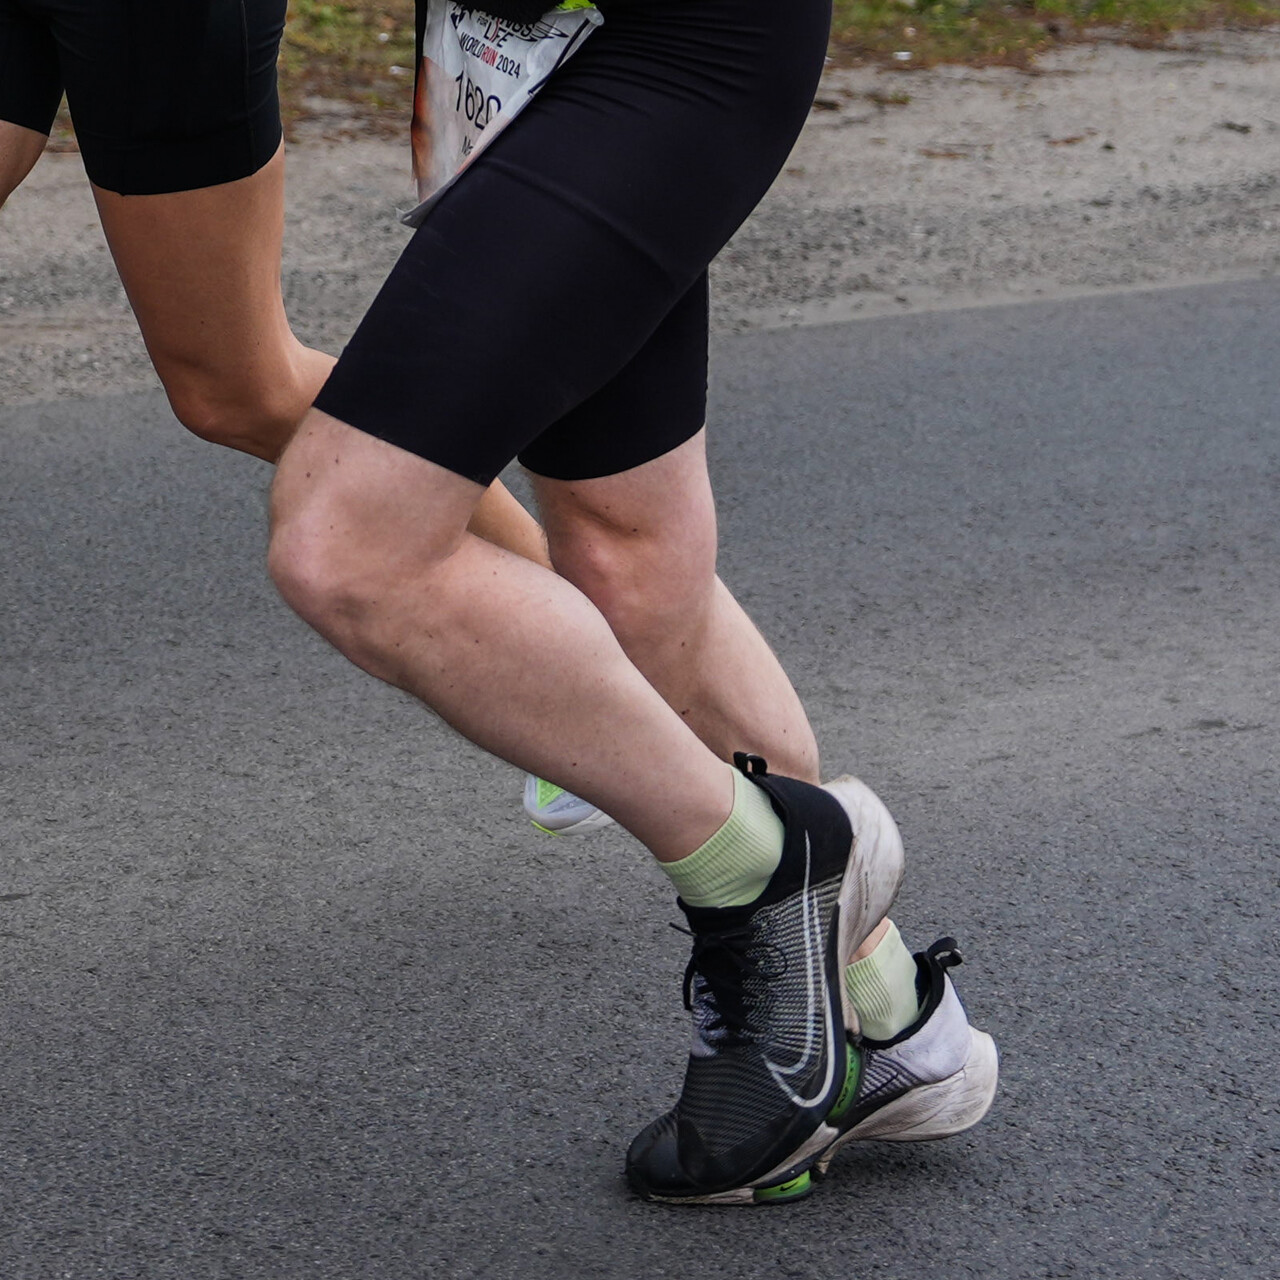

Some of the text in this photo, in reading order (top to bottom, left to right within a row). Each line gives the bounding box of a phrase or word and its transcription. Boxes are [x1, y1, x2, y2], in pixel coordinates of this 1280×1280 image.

[483, 21, 515, 48] LIFE
[461, 31, 521, 79] WORLD RUN 2024
